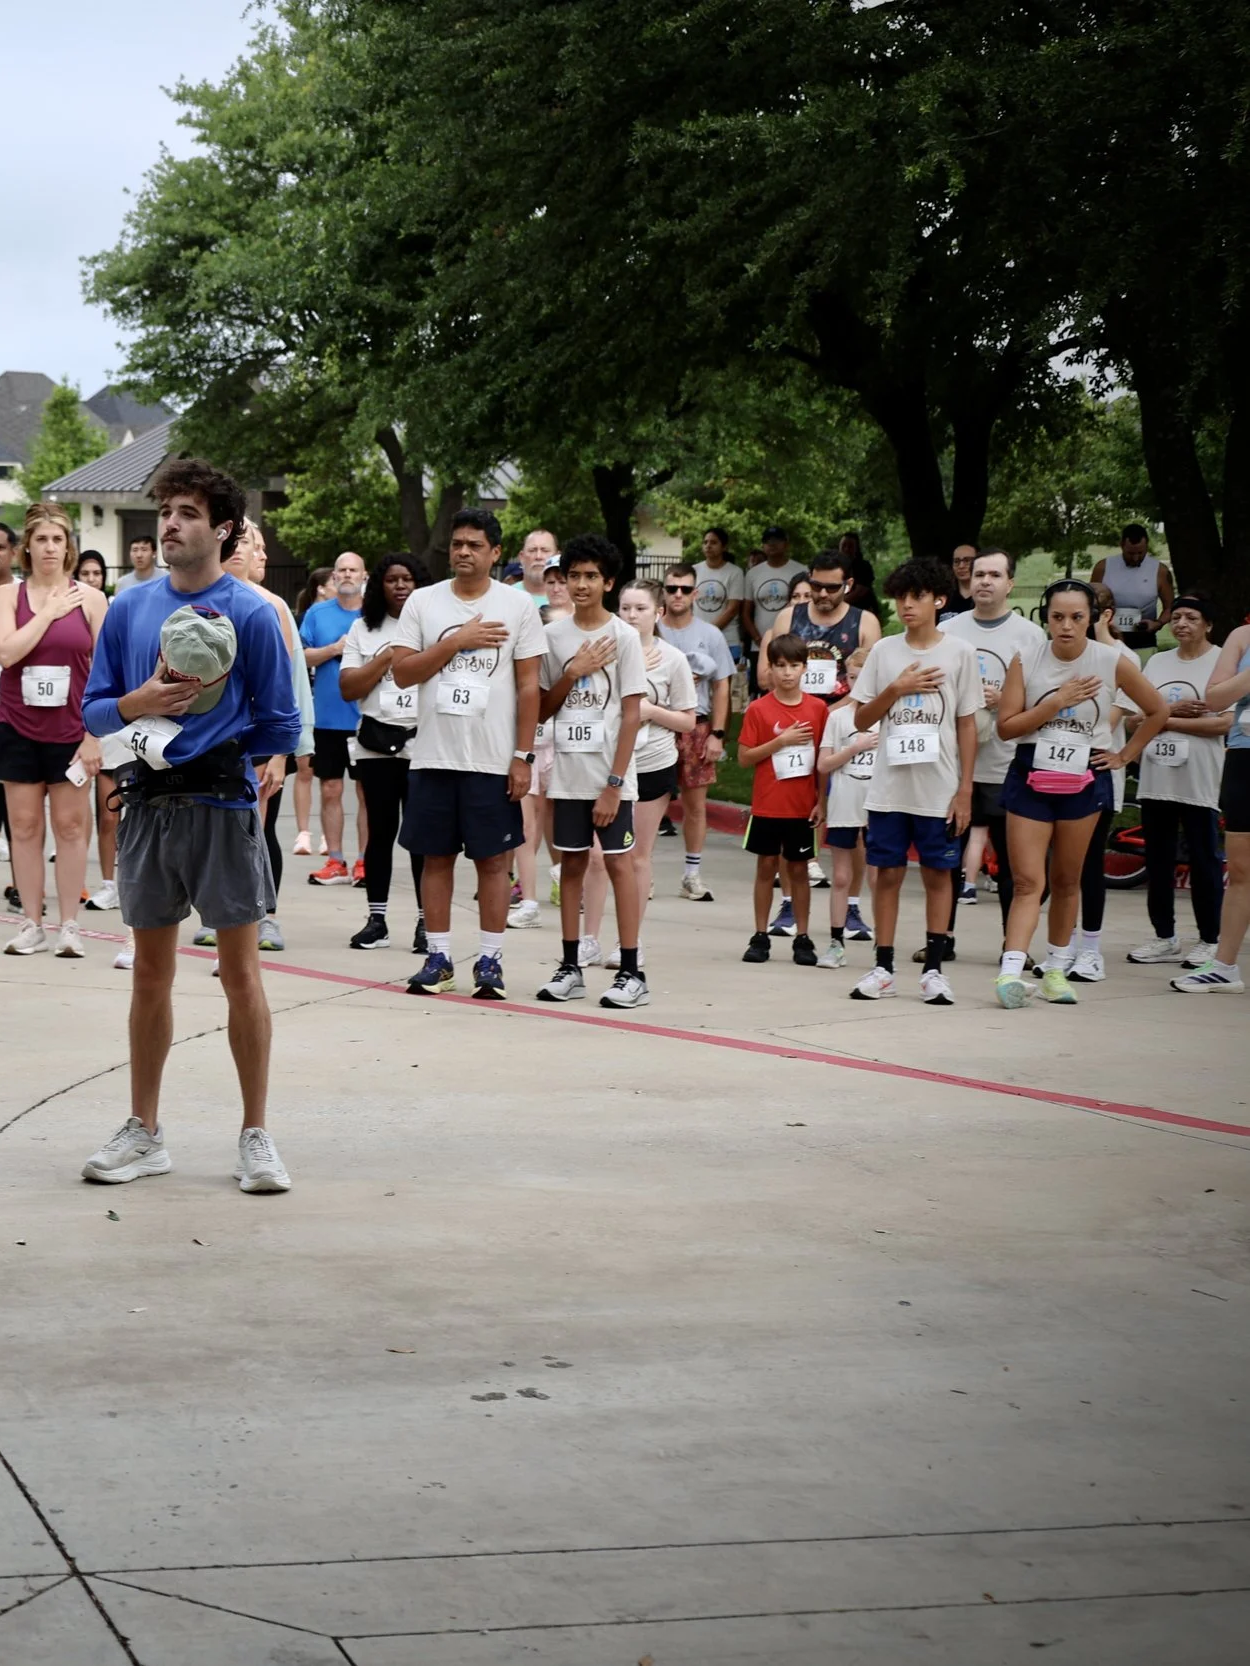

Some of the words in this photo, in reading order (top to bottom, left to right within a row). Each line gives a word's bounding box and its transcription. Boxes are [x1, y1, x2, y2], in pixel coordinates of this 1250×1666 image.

[447, 655, 494, 673] USTANG
[804, 672, 825, 685] 138
[37, 681, 54, 696] 50
[396, 694, 413, 708] 42
[452, 688, 471, 705] 63
[567, 726, 592, 741] 105
[131, 731, 149, 755] 54
[899, 738, 926, 754] 148
[1155, 742, 1176, 757] 139
[788, 753, 804, 767] 71
[851, 752, 874, 766] 123
[1048, 745, 1076, 762] 147
